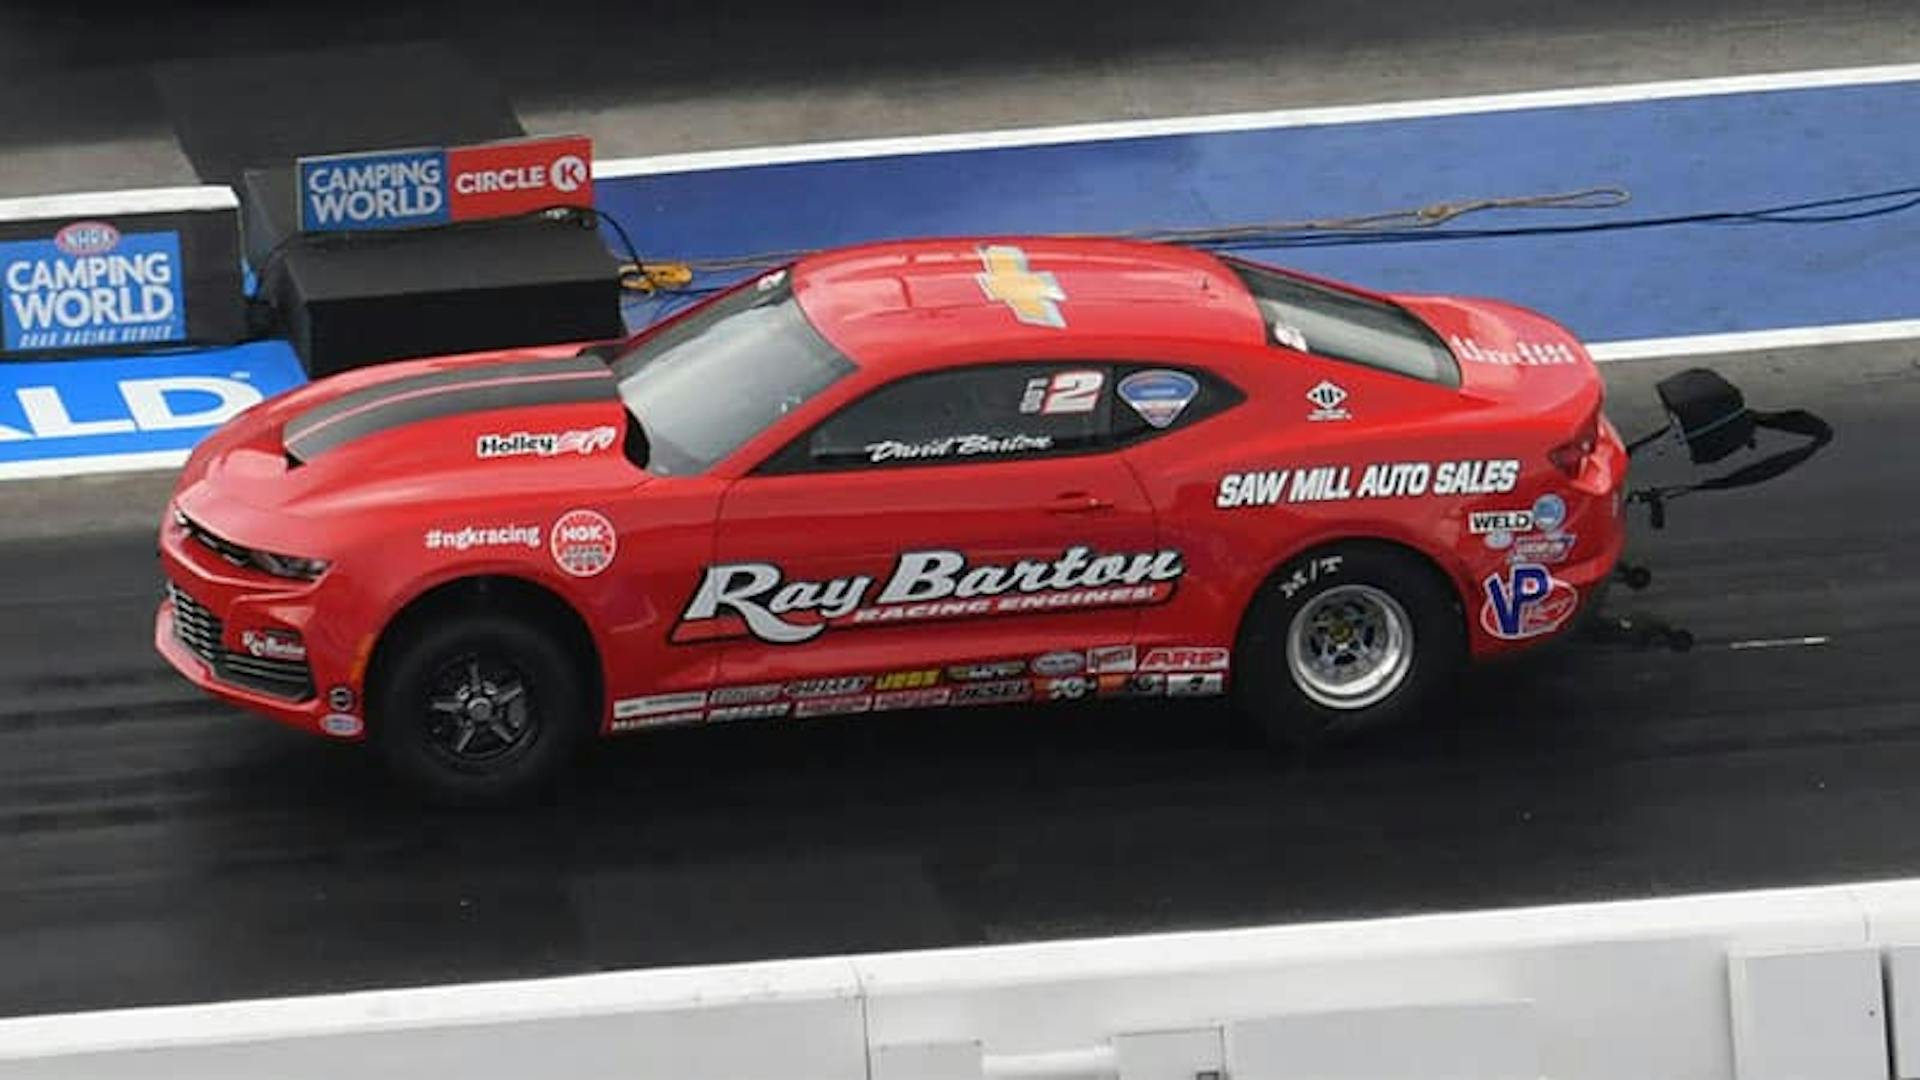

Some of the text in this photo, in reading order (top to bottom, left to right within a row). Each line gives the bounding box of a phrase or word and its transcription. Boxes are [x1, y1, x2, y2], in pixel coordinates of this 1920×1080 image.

[309, 160, 441, 193] CAMPING
[455, 155, 587, 194] CIRCLE K
[310, 187, 443, 224] WORLD
[7, 252, 171, 292] CAMPING
[10, 285, 174, 330] WORLD
[1043, 370, 1104, 415] 2
[478, 434, 555, 456] Holley
[1217, 459, 1520, 508] SAW MILL AUTO SALES
[425, 524, 541, 551] #ngkracing
[1472, 514, 1530, 529] WELD
[682, 544, 1184, 643] Ray Barton
[853, 601, 991, 624] RACING
[1485, 566, 1551, 635] VP
